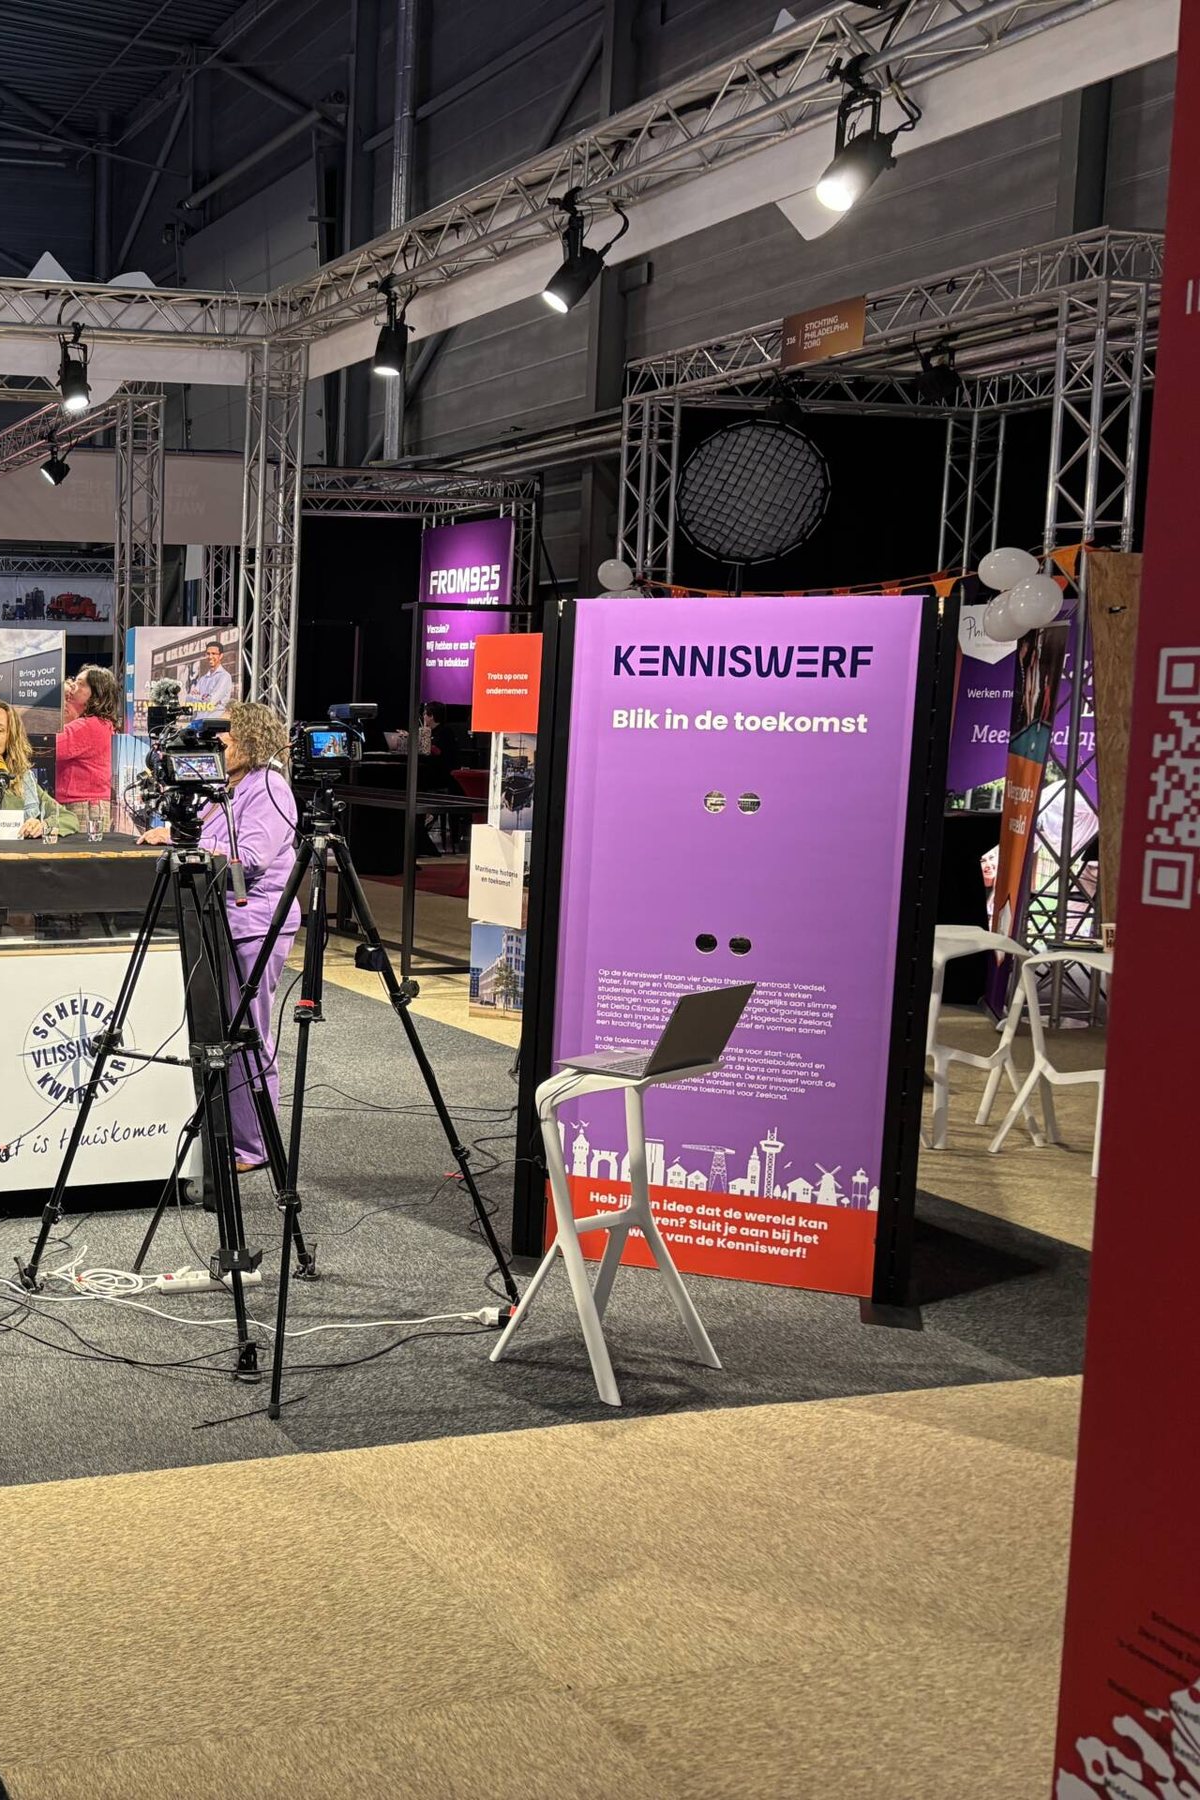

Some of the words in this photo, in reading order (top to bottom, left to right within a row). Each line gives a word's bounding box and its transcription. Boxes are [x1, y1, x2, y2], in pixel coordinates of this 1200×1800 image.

[803, 322, 848, 341] PHILADELPHIA
[804, 315, 838, 331] STICHTING
[429, 565, 500, 595] FROM925
[613, 645, 874, 678] KENNISWERF
[19, 670, 36, 678] Bring
[37, 667, 56, 677] your
[504, 674, 511, 682] op
[19, 678, 56, 687] innovation
[486, 687, 528, 695] ondernemers
[19, 690, 26, 698] to
[27, 689, 38, 698] life
[968, 688, 1000, 699] Werken
[612, 708, 659, 729] Blik
[665, 708, 689, 730] in
[695, 710, 729, 731] de
[734, 712, 868, 733] toekomst
[598, 968, 610, 977] Op
[611, 969, 621, 977] de
[622, 970, 662, 980] Kenniswerf
[687, 974, 700, 982] vier
[702, 976, 722, 984] Delta
[598, 977, 622, 986] Water,
[623, 979, 651, 988] Energie
[753, 989, 782, 997] hema's
[784, 991, 812, 999] werken
[597, 993, 642, 1003] oplossingen
[743, 1006, 768, 1014] orgen.
[770, 1007, 820, 1017] Organisaties
[598, 985, 636, 995] studenten,
[637, 989, 680, 997] onderzoeke
[753, 997, 788, 1007] dagelijks
[807, 1001, 837, 1010] slimme
[611, 1020, 641, 1030] krachtig
[631, 1004, 660, 1013] Climate
[750, 1015, 798, 1024] Hogeschool
[799, 1018, 833, 1028] Zeeland,
[766, 1025, 797, 1033] vormen
[798, 1027, 826, 1035] samen
[31, 1037, 97, 1069] VLISSIN
[614, 1036, 649, 1045] toekomst
[764, 1050, 802, 1060] start-ups,
[738, 1056, 814, 1068] Innovatieboulevard
[746, 1065, 765, 1073] kans
[781, 1068, 809, 1077] samen
[706, 1078, 734, 1087] worden
[748, 1082, 767, 1090] waar
[769, 1084, 805, 1093] innovatie
[712, 1071, 743, 1080] groeien.
[757, 1074, 798, 1084] Kenniswerf
[800, 1078, 823, 1087] wordt
[659, 1083, 698, 1092] duurzame
[699, 1086, 735, 1095] toekomst
[755, 1091, 788, 1101] Zeeland.
[32, 1135, 50, 1154] is
[59, 1120, 168, 1150] tuiskomen
[589, 1191, 617, 1204] Heb
[618, 1194, 632, 1210] jij
[663, 1200, 693, 1215] idee
[696, 1204, 722, 1219] dat
[724, 1206, 742, 1221] de
[744, 1209, 796, 1226] wereld
[799, 1215, 828, 1231] kan
[689, 1219, 722, 1233] Sluit
[723, 1222, 737, 1237] je
[740, 1226, 770, 1239] aan
[772, 1227, 791, 1245] bij
[793, 1231, 819, 1245] het
[666, 1232, 695, 1245] van
[696, 1233, 714, 1247] de
[717, 1237, 807, 1259] Kenniswerf!
